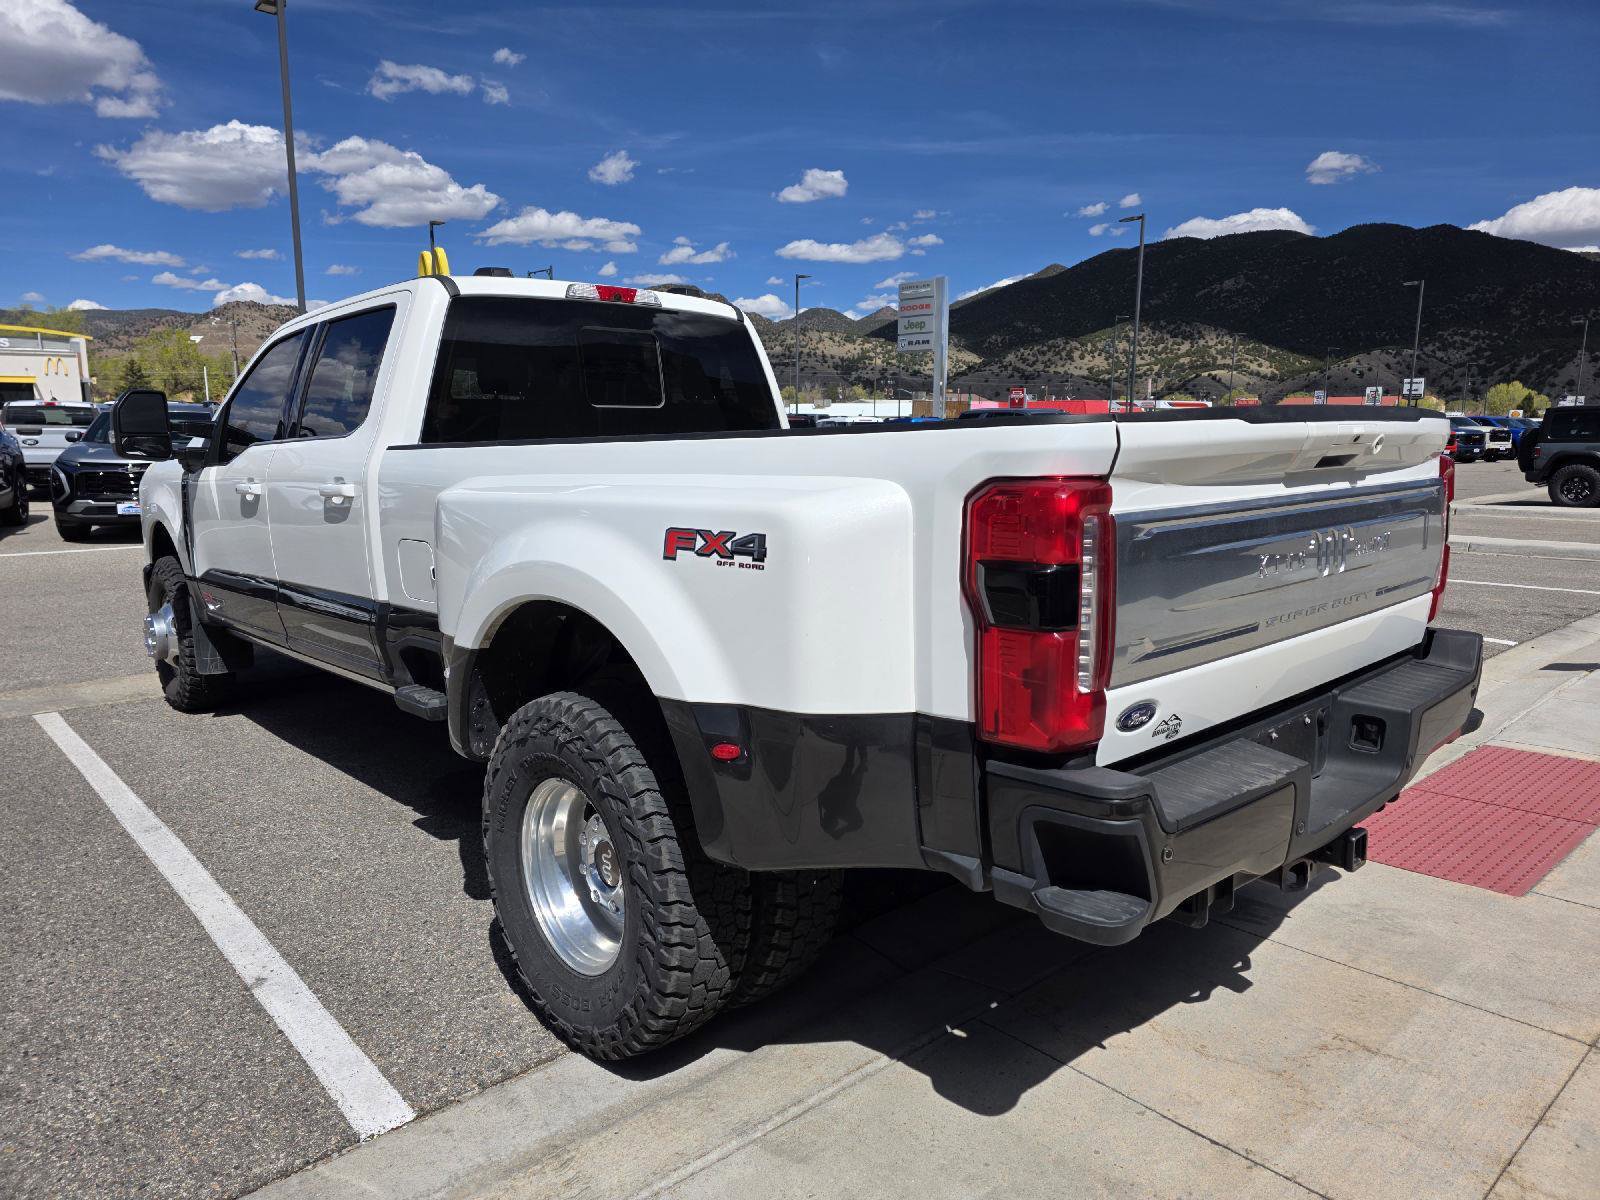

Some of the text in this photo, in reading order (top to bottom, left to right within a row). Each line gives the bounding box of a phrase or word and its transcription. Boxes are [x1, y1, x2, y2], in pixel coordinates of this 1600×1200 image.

[903, 319, 926, 331] Jeep
[907, 338, 930, 346] RAM
[663, 527, 767, 563] FX4
[738, 562, 765, 571] ROAD
